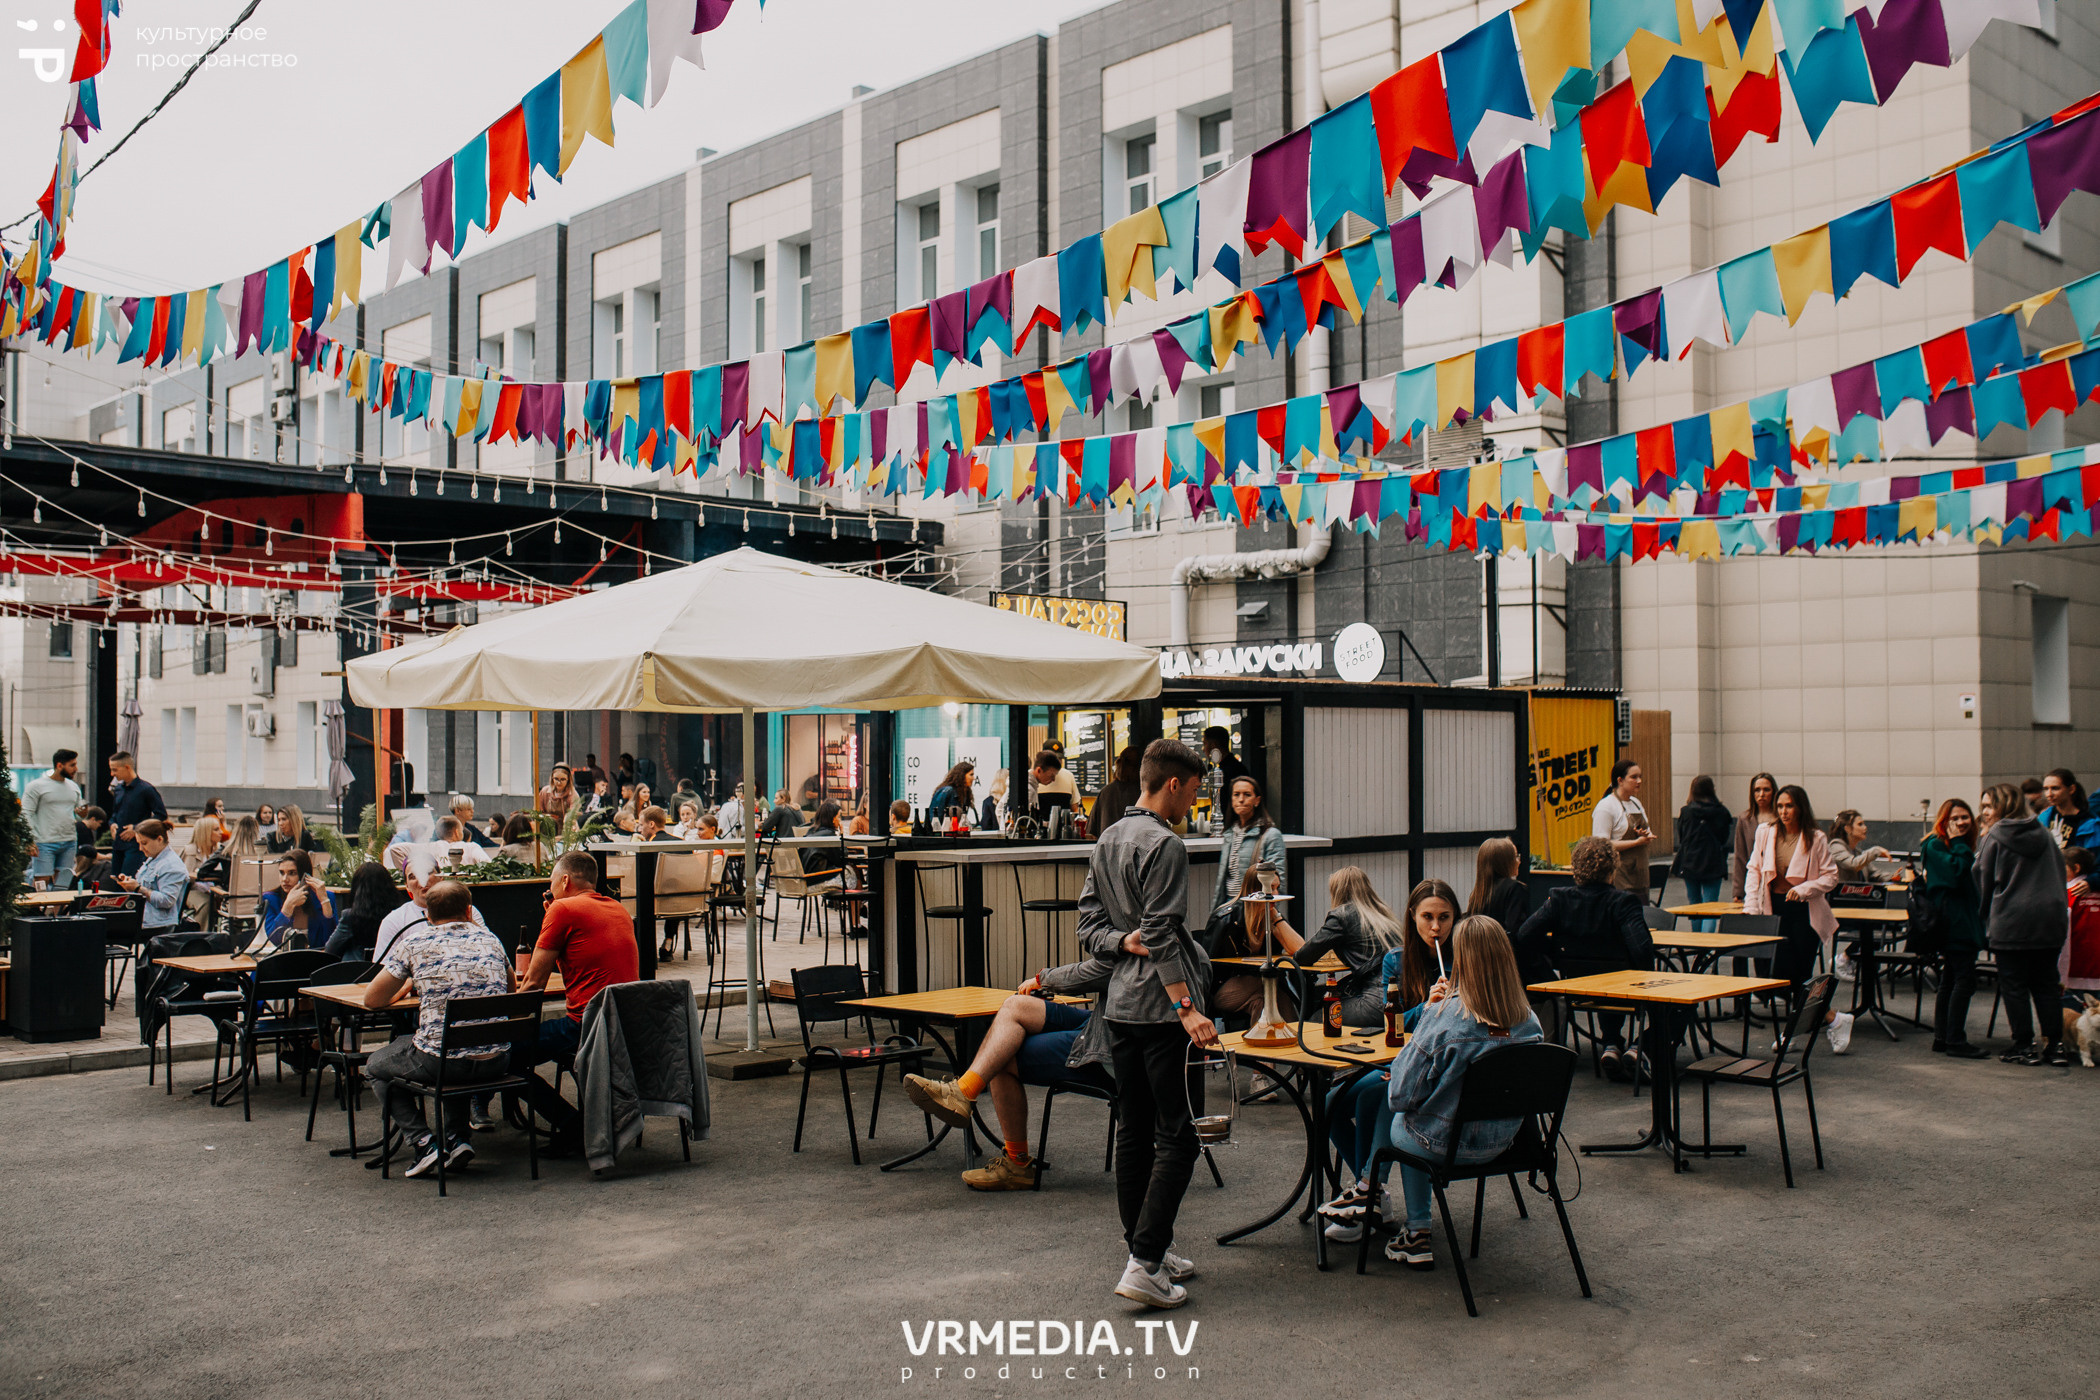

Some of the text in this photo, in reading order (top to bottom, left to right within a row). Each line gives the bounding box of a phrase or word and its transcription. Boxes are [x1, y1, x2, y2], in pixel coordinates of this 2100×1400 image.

[1203, 643, 1323, 675] ЗАКУСКИ
[1339, 637, 1376, 662] STREET
[1345, 650, 1373, 669] FOOD
[907, 756, 921, 768] CO
[1528, 744, 1599, 788] STREET
[908, 775, 917, 786] FF
[908, 793, 918, 804] EE
